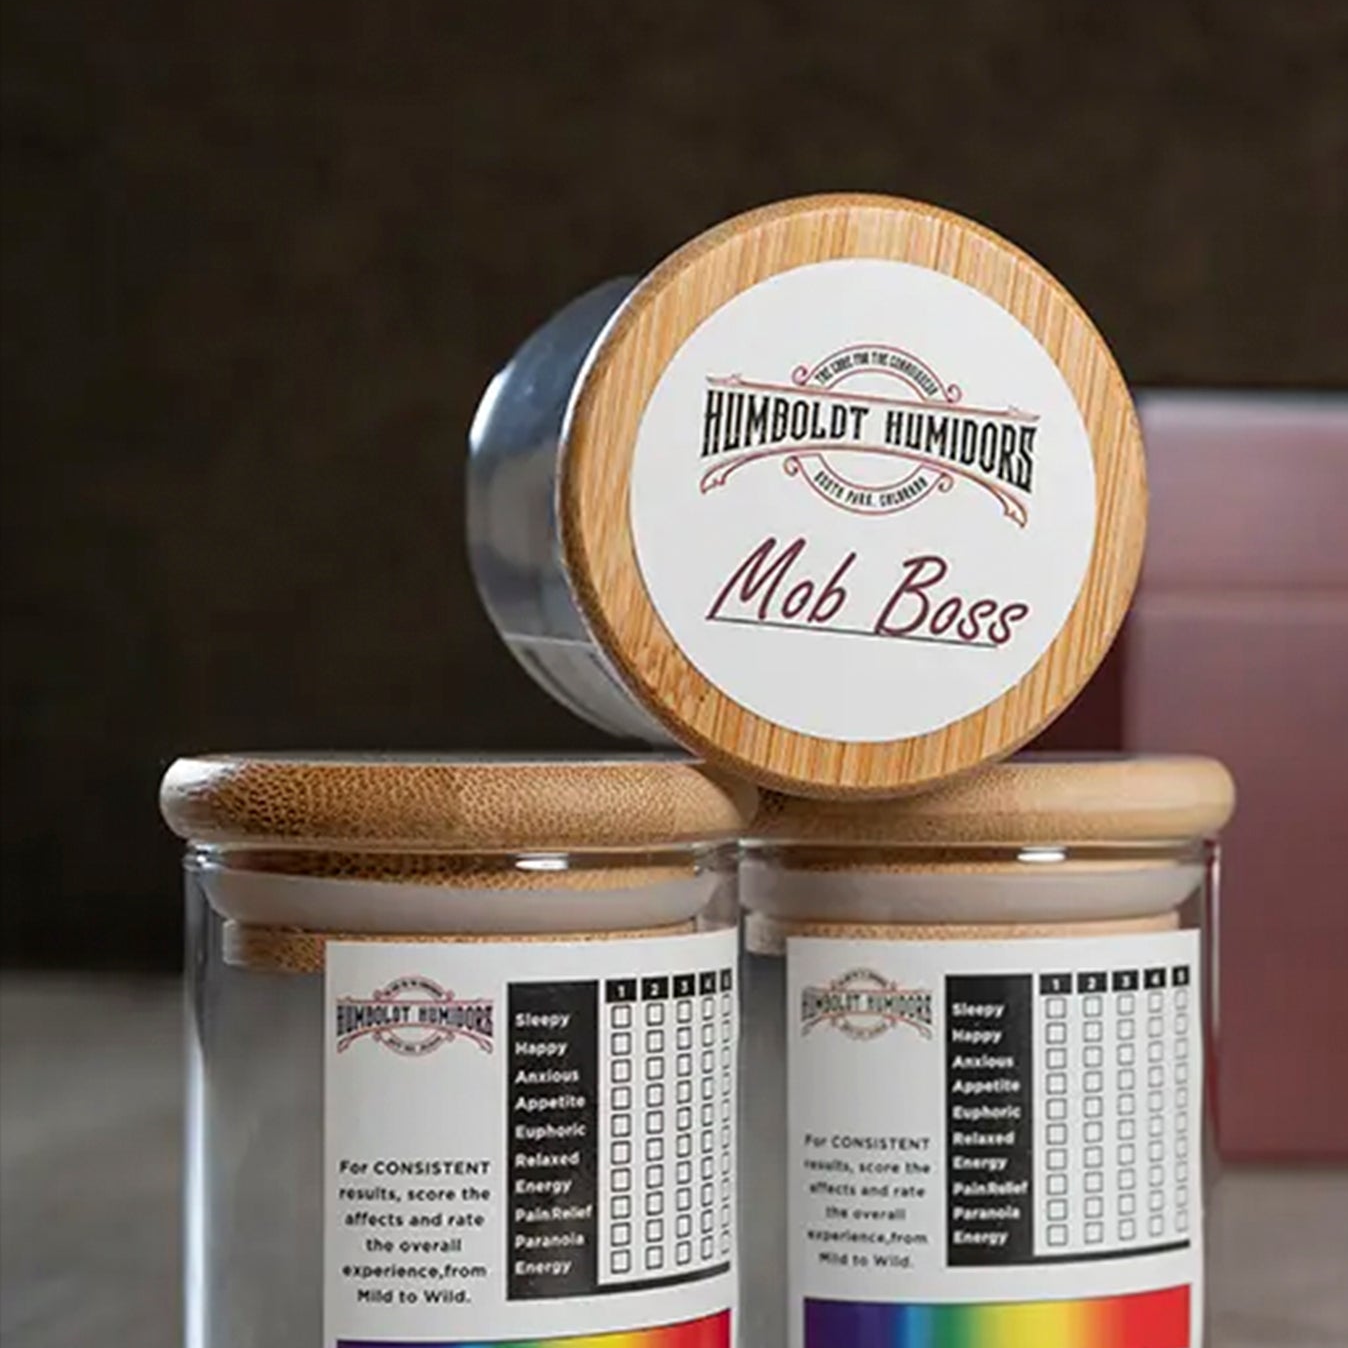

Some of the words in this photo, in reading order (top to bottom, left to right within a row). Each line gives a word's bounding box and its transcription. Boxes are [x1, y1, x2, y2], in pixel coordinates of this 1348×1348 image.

[701, 389, 870, 457] HUMBOLDT
[883, 410, 1038, 494] HUMIDORS
[706, 537, 858, 622] Mob
[874, 554, 1030, 645] Boss
[618, 986, 625, 998] 1
[651, 983, 659, 996] 2
[681, 980, 688, 993] 3
[1052, 979, 1060, 990] 1
[1087, 977, 1096, 989] 2
[952, 1003, 1004, 1018] Sleepy
[515, 1012, 570, 1028] Sleepy
[952, 1029, 1002, 1044] Happy
[515, 1041, 567, 1056] Happy
[952, 1055, 1014, 1068] Anxious
[515, 1070, 579, 1084] Anxious
[952, 1080, 1020, 1094] Appetite
[515, 1095, 586, 1111] Appetite
[952, 1105, 1021, 1121] Euphoric
[515, 1123, 586, 1140] Euphoric
[952, 1131, 1015, 1145] Relaxed
[831, 1134, 930, 1150] CONSISTENT
[339, 1160, 368, 1175] For
[373, 1160, 490, 1175] CONSISTENT
[515, 1152, 580, 1168] Relaxed
[952, 1156, 1008, 1172] Energy
[339, 1187, 401, 1202] results,
[407, 1189, 456, 1201] score
[461, 1187, 490, 1201] the
[515, 1179, 572, 1195] Energy
[345, 1212, 403, 1226] affects
[409, 1213, 443, 1226] and
[449, 1214, 485, 1226] rate
[952, 1205, 1021, 1220] Paranoia
[515, 1233, 585, 1249] Paranoia
[952, 1230, 1009, 1245] Energy
[366, 1239, 394, 1252] the
[399, 1239, 462, 1252] overall
[515, 1261, 572, 1276] Energy
[357, 1289, 393, 1303] Mild
[399, 1291, 418, 1303] to
[423, 1290, 471, 1303] Wild.
